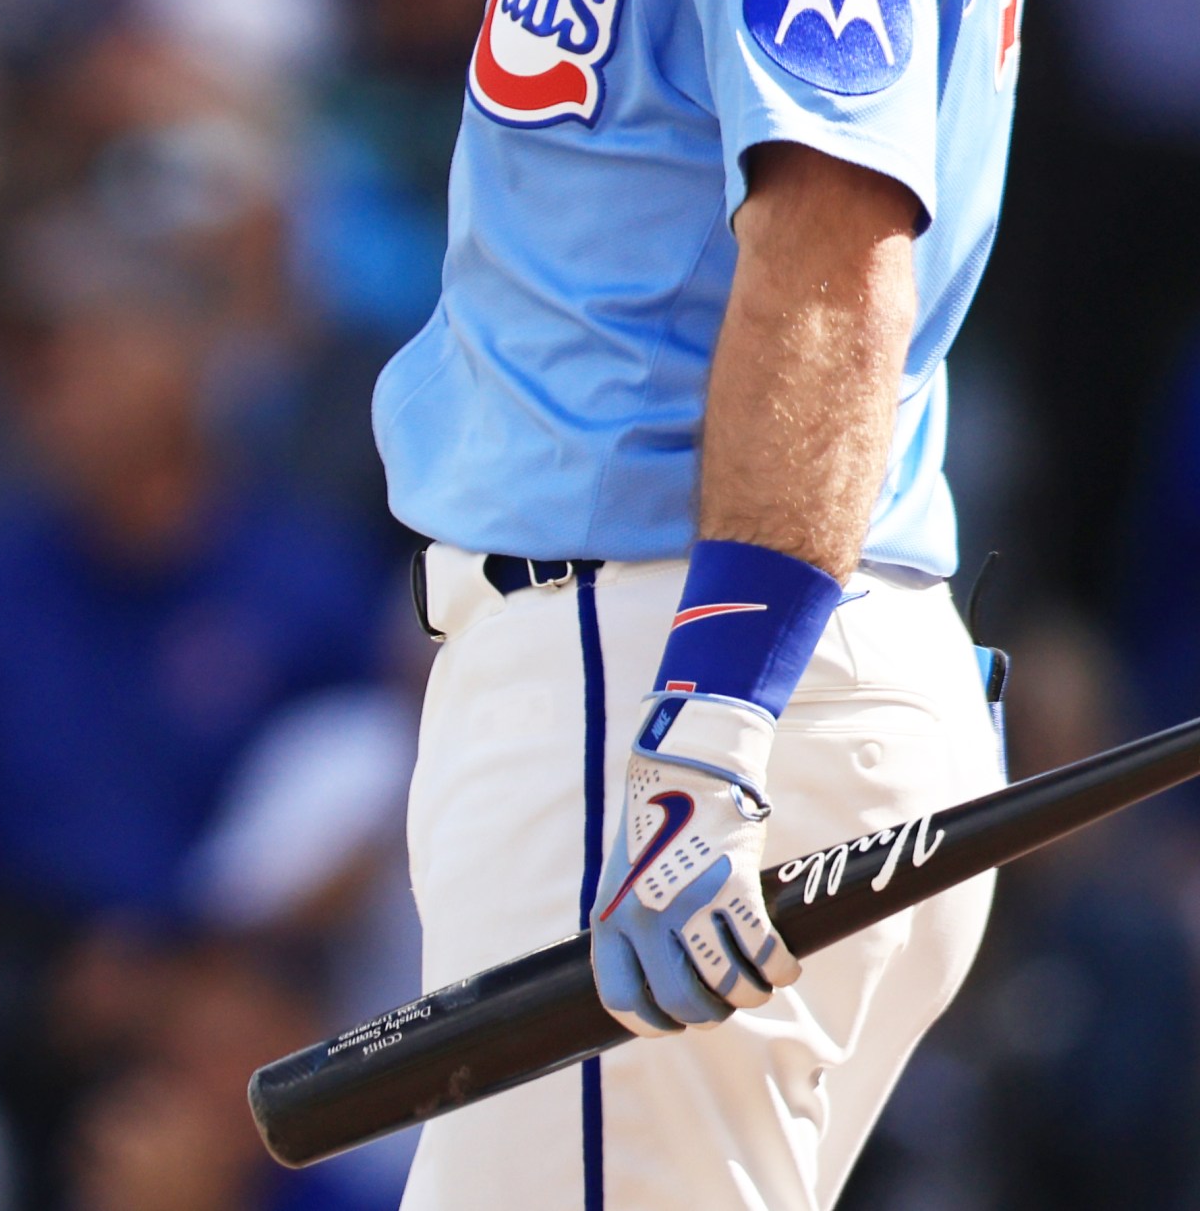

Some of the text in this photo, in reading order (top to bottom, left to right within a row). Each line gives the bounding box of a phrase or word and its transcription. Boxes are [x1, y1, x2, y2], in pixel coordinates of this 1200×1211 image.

[651, 708, 672, 740] NIKE
[384, 1005, 431, 1031] Dansby
[327, 1026, 382, 1057] Swanson
